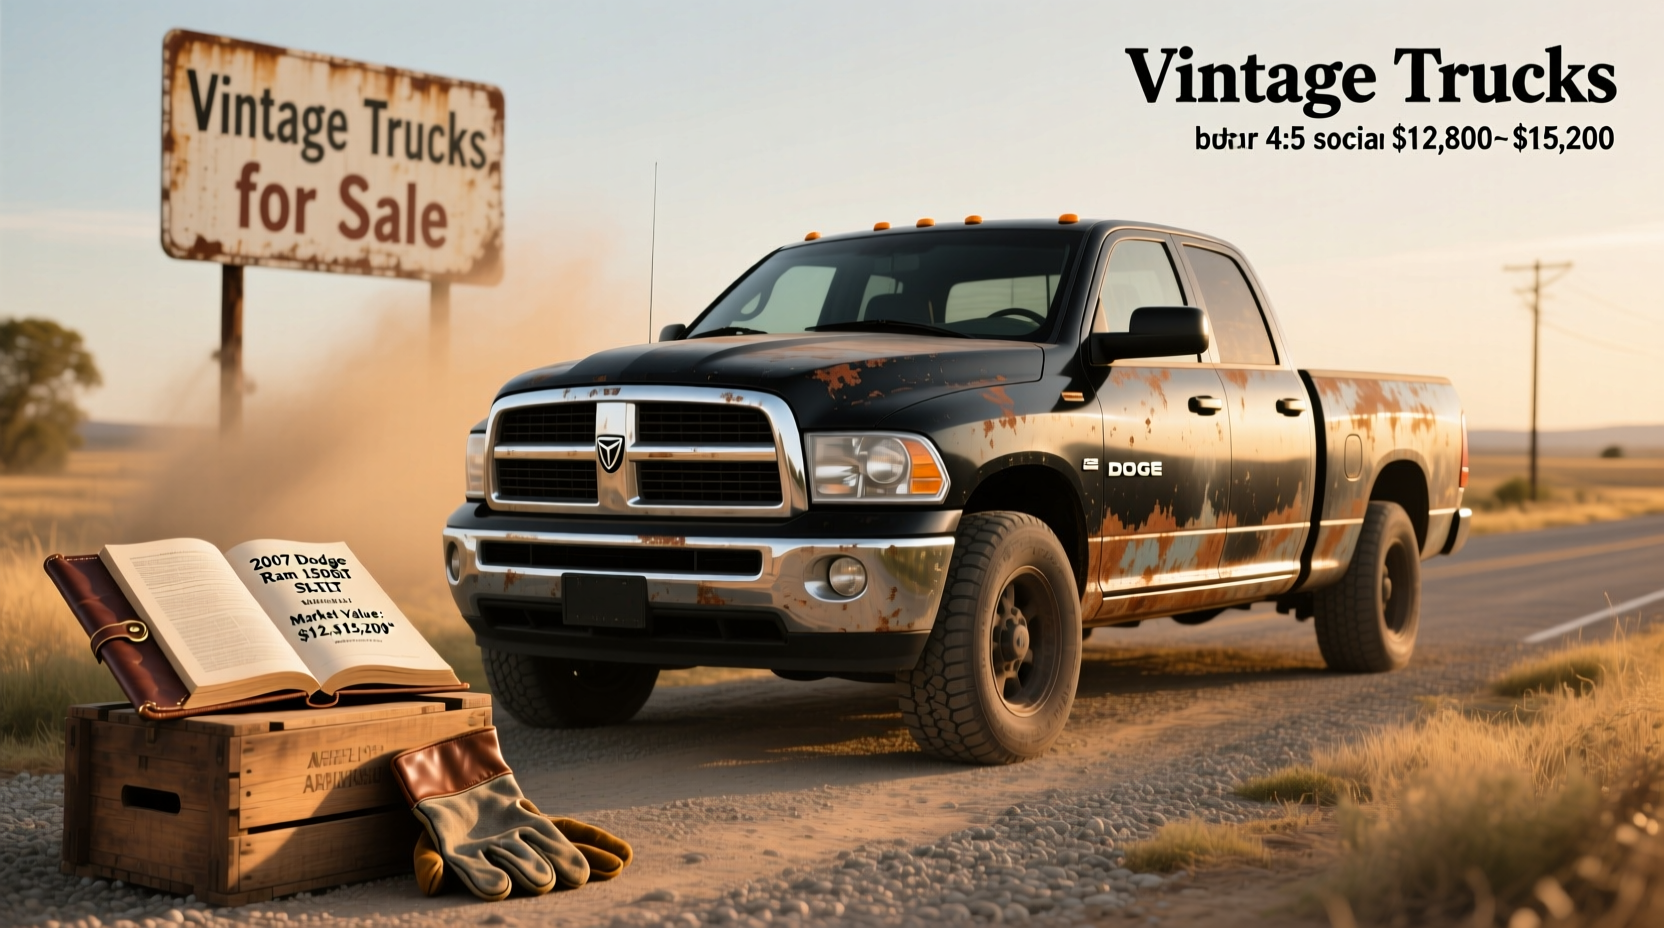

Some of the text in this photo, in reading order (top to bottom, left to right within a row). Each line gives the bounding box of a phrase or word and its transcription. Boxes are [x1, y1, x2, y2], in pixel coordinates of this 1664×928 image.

[187, 69, 487, 169] Vintage Trucks
[236, 162, 448, 248] for Sale
[1108, 461, 1163, 477] DOGE
[250, 554, 347, 571] 2007 Dodge
[260, 571, 299, 584] Ram
[290, 608, 384, 626] Market Value:
